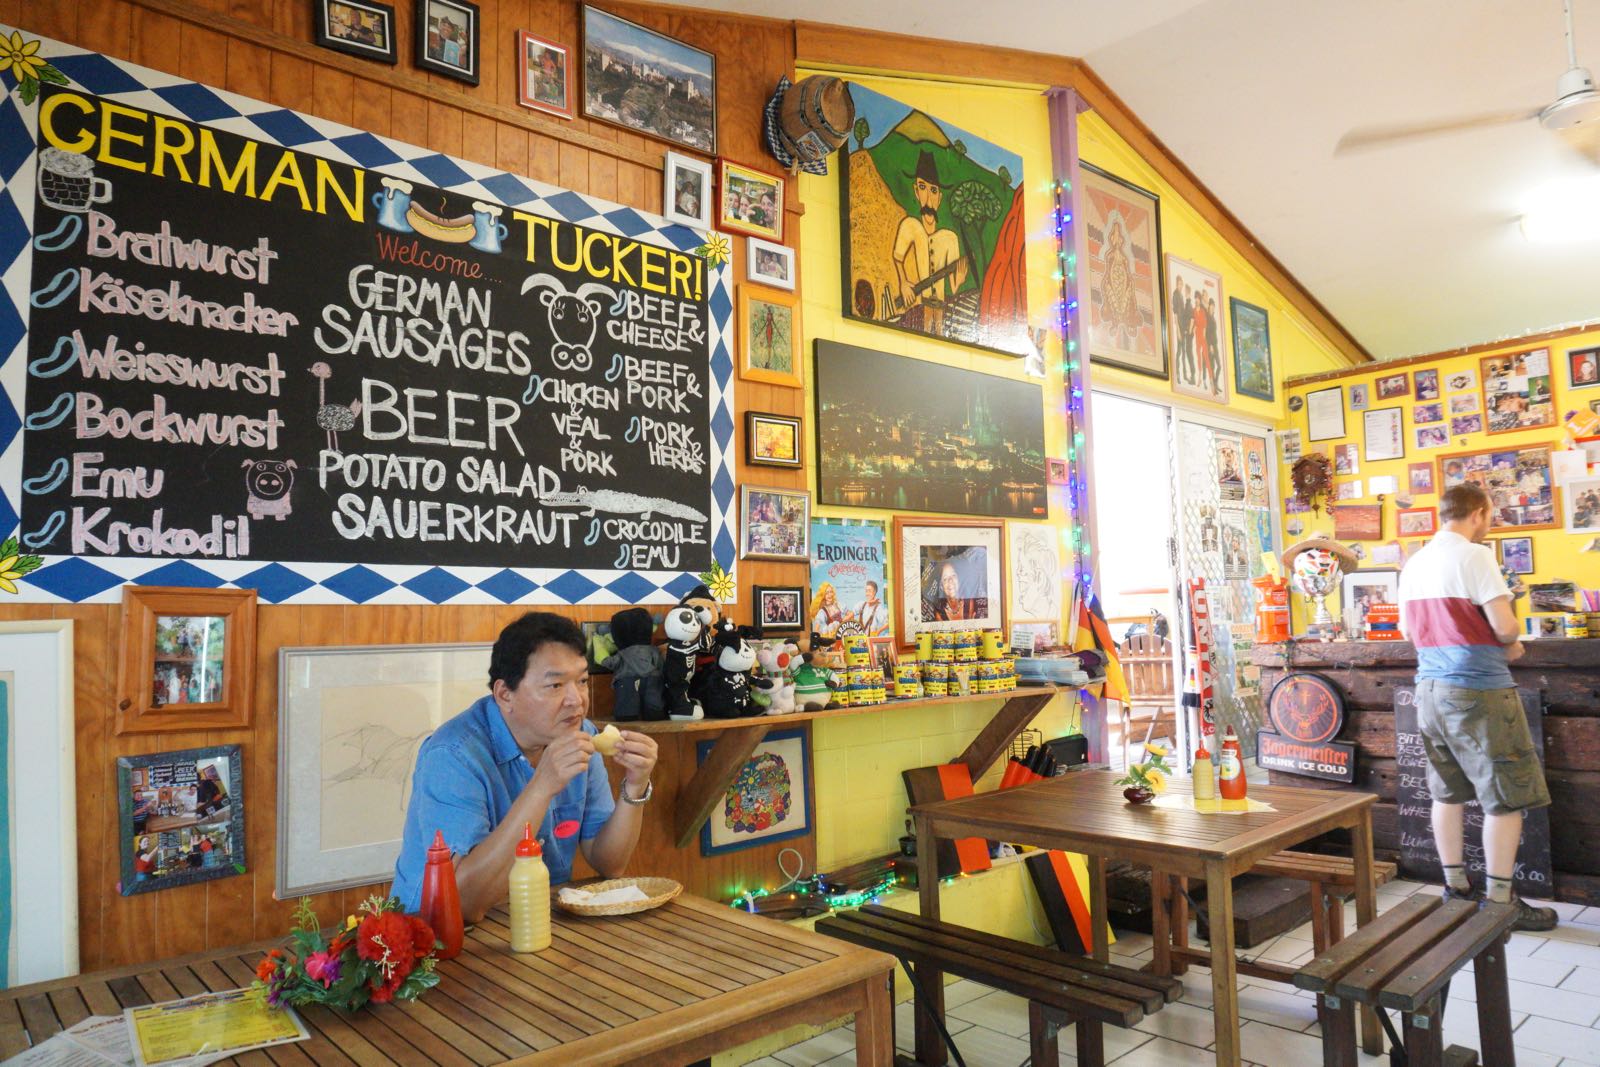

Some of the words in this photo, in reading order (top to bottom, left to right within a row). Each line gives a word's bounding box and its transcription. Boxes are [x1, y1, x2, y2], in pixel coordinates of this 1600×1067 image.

[39, 93, 366, 223] GERMAN
[513, 211, 703, 301] TUCKER!
[87, 211, 279, 284] Bratwurst
[78, 266, 300, 337] Käseknacker
[348, 264, 492, 328] GERMAN
[627, 289, 699, 329] BEEF
[688, 318, 706, 345] &
[313, 304, 532, 376] SAUSAGES
[606, 320, 692, 352] CHEESE
[72, 329, 287, 397] Weisswurst
[624, 355, 689, 387] BEEF
[686, 372, 703, 398] &
[361, 377, 525, 456] BEER
[540, 377, 619, 411] CHICKEN
[627, 380, 691, 414] PORK
[76, 391, 285, 451] Bockwurst
[551, 412, 612, 441] VEAL
[641, 415, 697, 449] PORK
[691, 441, 706, 465] &
[72, 452, 165, 499] Emu
[318, 450, 447, 492] POTATO
[456, 455, 561, 500] SALAD
[560, 447, 617, 477] PORK
[71, 506, 250, 558] Krokodil
[331, 493, 579, 549] SAUERKRAUT
[603, 518, 708, 545] CROCODILE
[632, 544, 681, 569] EMU
[816, 543, 880, 563] ERDINGER
[1262, 756, 1295, 769] DRINK
[1298, 761, 1316, 771] ICE
[1317, 763, 1348, 775] COLD
